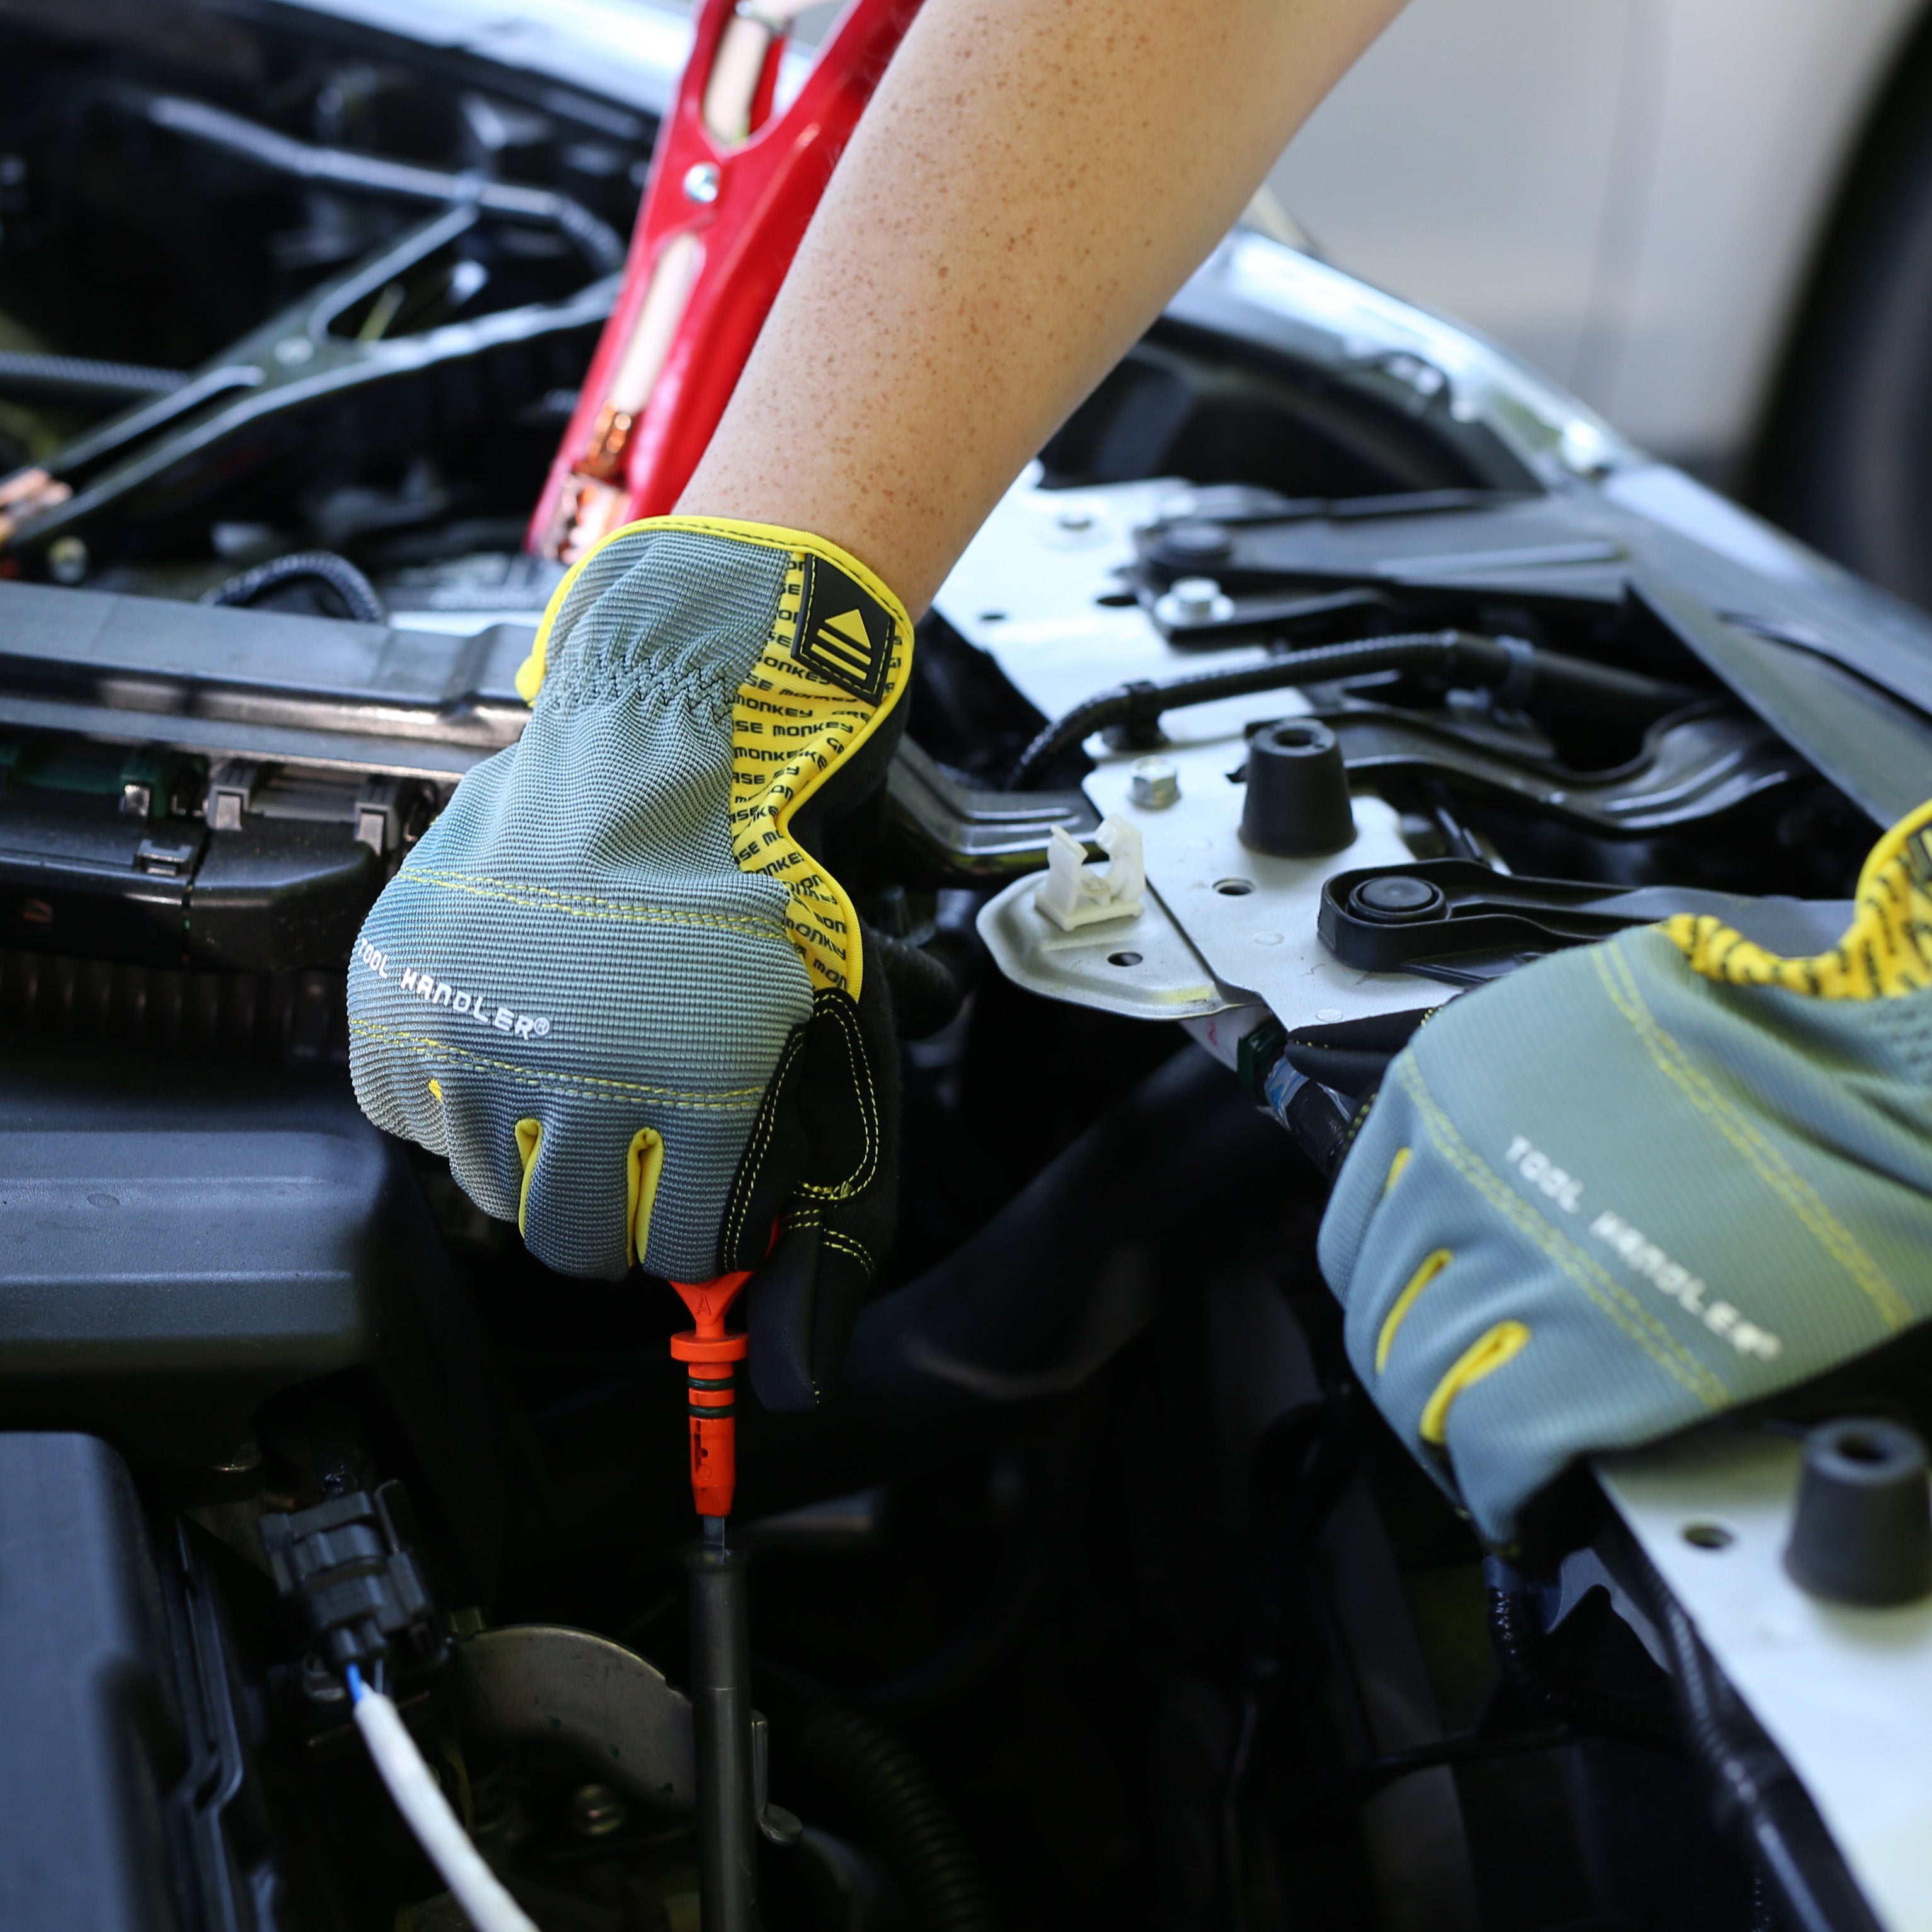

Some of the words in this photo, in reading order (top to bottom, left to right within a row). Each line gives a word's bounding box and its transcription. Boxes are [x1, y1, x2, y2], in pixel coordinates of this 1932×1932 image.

[758, 656, 831, 685] ONKE
[773, 721, 853, 737] MONKEY
[734, 746, 803, 762] MONKE
[357, 937, 389, 979] TOOL
[1505, 1134, 1584, 1214] TOOL
